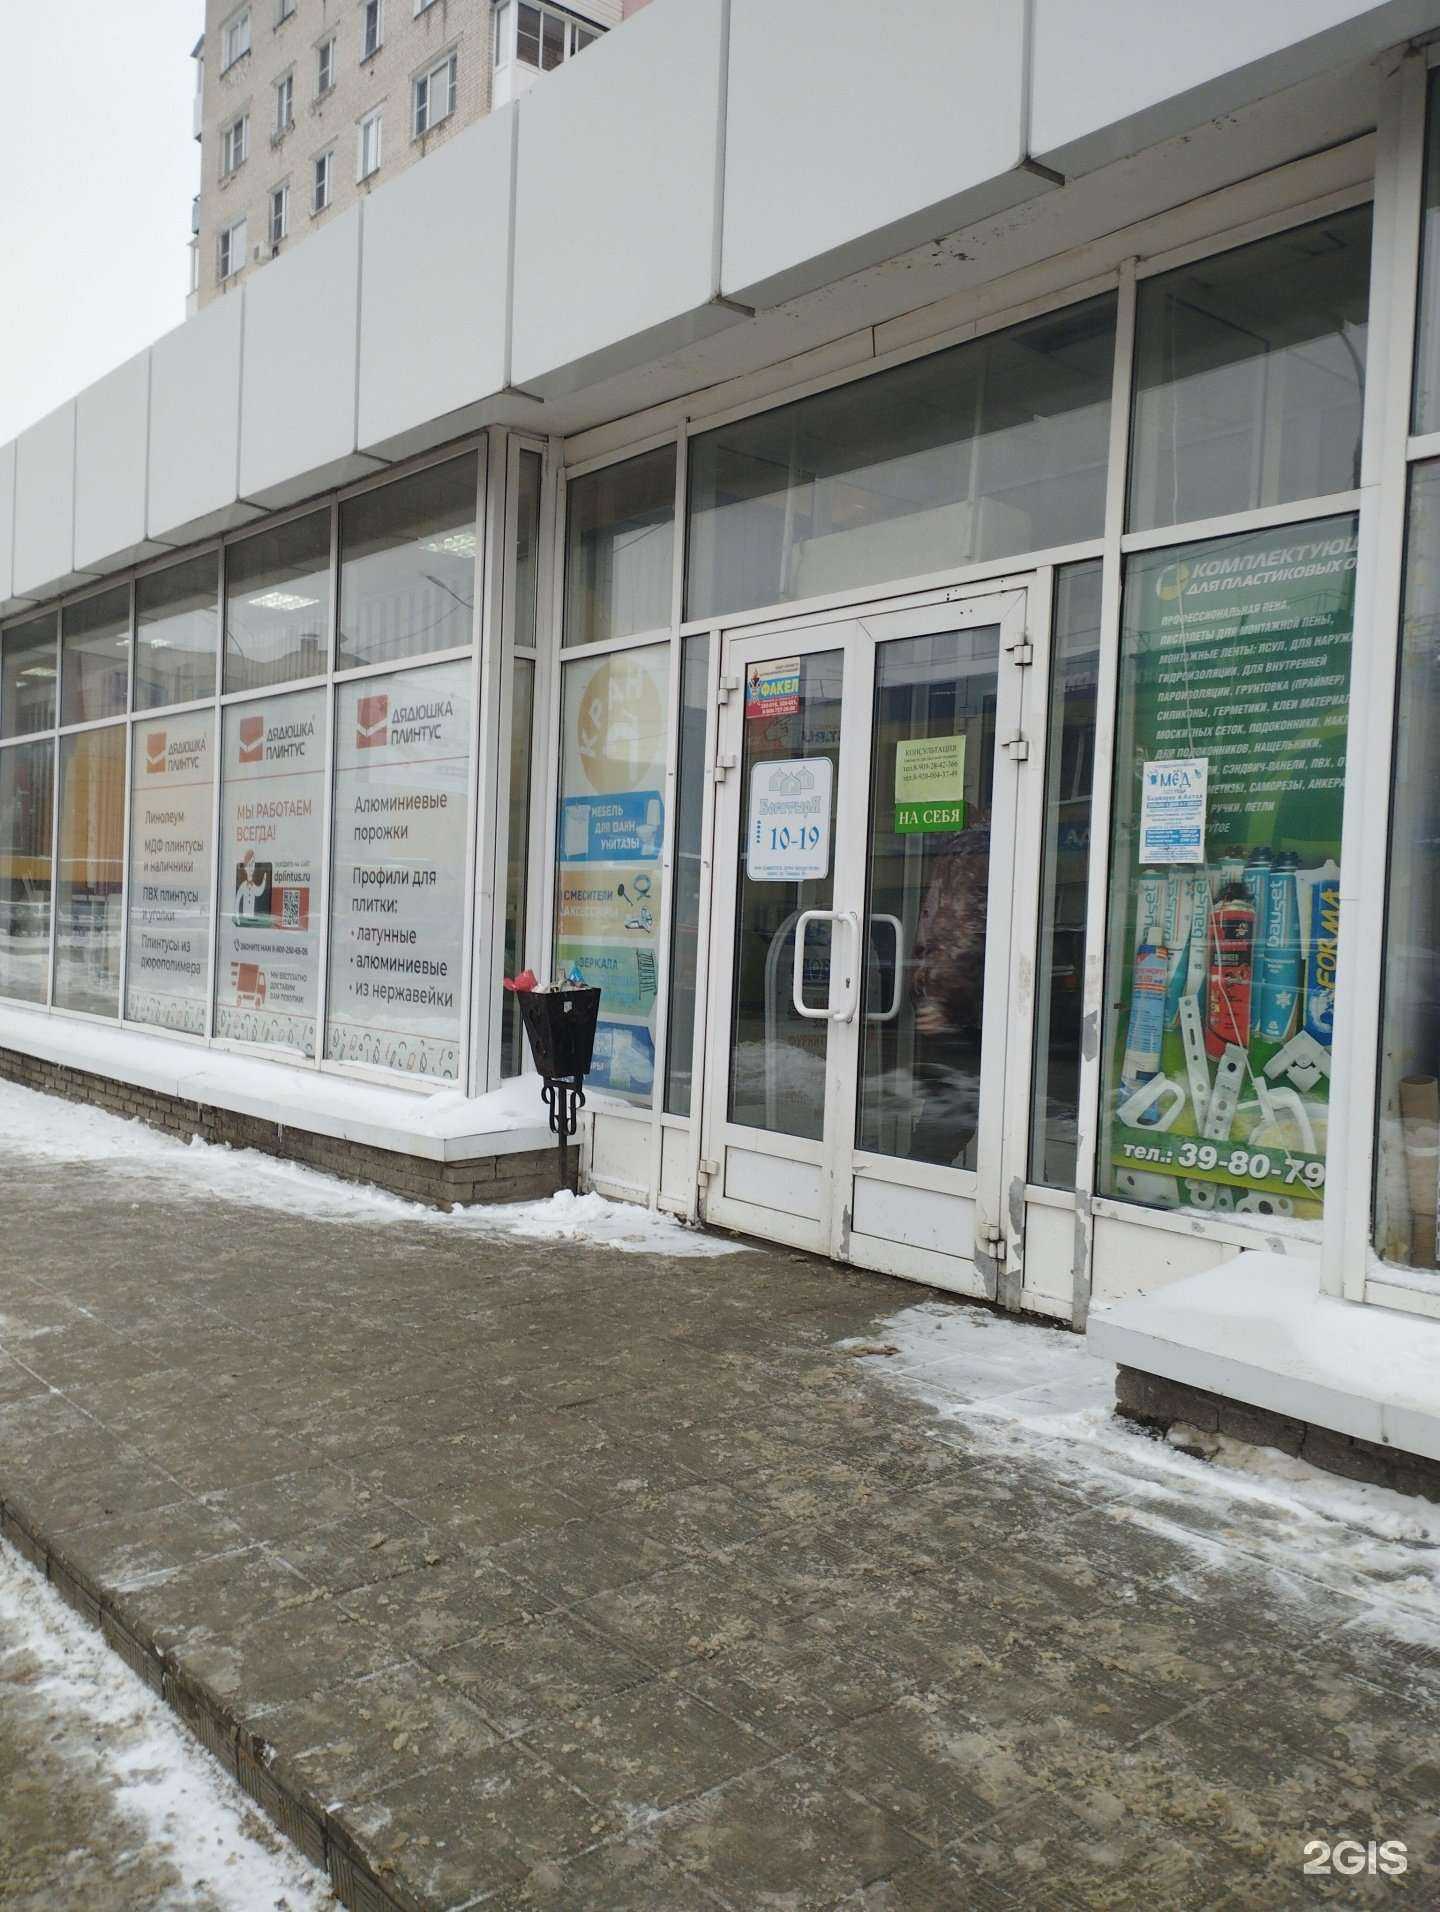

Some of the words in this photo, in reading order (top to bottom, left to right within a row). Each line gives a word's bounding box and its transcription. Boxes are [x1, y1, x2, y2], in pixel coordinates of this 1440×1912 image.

[1220, 559, 1343, 592] ПЛАСТИКОВЫХ
[1343, 556, 1357, 571] О
[1289, 636, 1313, 652] ДЛЯ
[1241, 662, 1264, 677] ДЛЯ
[761, 677, 800, 697] ФАКЕЛ
[392, 701, 453, 723] ДЯДЮШКА
[266, 721, 314, 742] ДЯДЮШКА
[391, 724, 442, 745] ПЛИНТУС
[266, 742, 305, 760] ПЛИНТУС
[237, 803, 254, 819] МЫ
[256, 799, 312, 818] РАБОТАЕМ
[355, 793, 448, 814] Алюминиевые
[591, 804, 624, 818] МЕБЕЛЬ
[145, 810, 185, 826] Линолеум
[899, 810, 919, 825] НА
[922, 808, 961, 825] СЕБЯ
[236, 823, 276, 843] ВСЕГДА!
[354, 824, 408, 845] порожки
[769, 825, 820, 850] 10-19
[145, 838, 164, 856] МДФ
[165, 839, 204, 856] плинтусы
[600, 837, 640, 851] УНИТАЗЫ
[150, 861, 194, 873] наличники
[353, 867, 409, 889] Профили
[412, 870, 437, 887] для
[160, 889, 199, 906] плинтусы
[563, 889, 614, 902] СМЕСИТЕЛИ
[1267, 880, 1282, 947] bauset
[141, 934, 180, 954] Плинтусы
[181, 940, 191, 953] из
[357, 926, 417, 946] латунные
[356, 954, 448, 977] алюминиевые
[355, 982, 369, 997] из
[373, 983, 455, 1008] нержавейки
[1123, 1143, 1172, 1164] тел.:
[1178, 1143, 1325, 1188] 39-80-79
